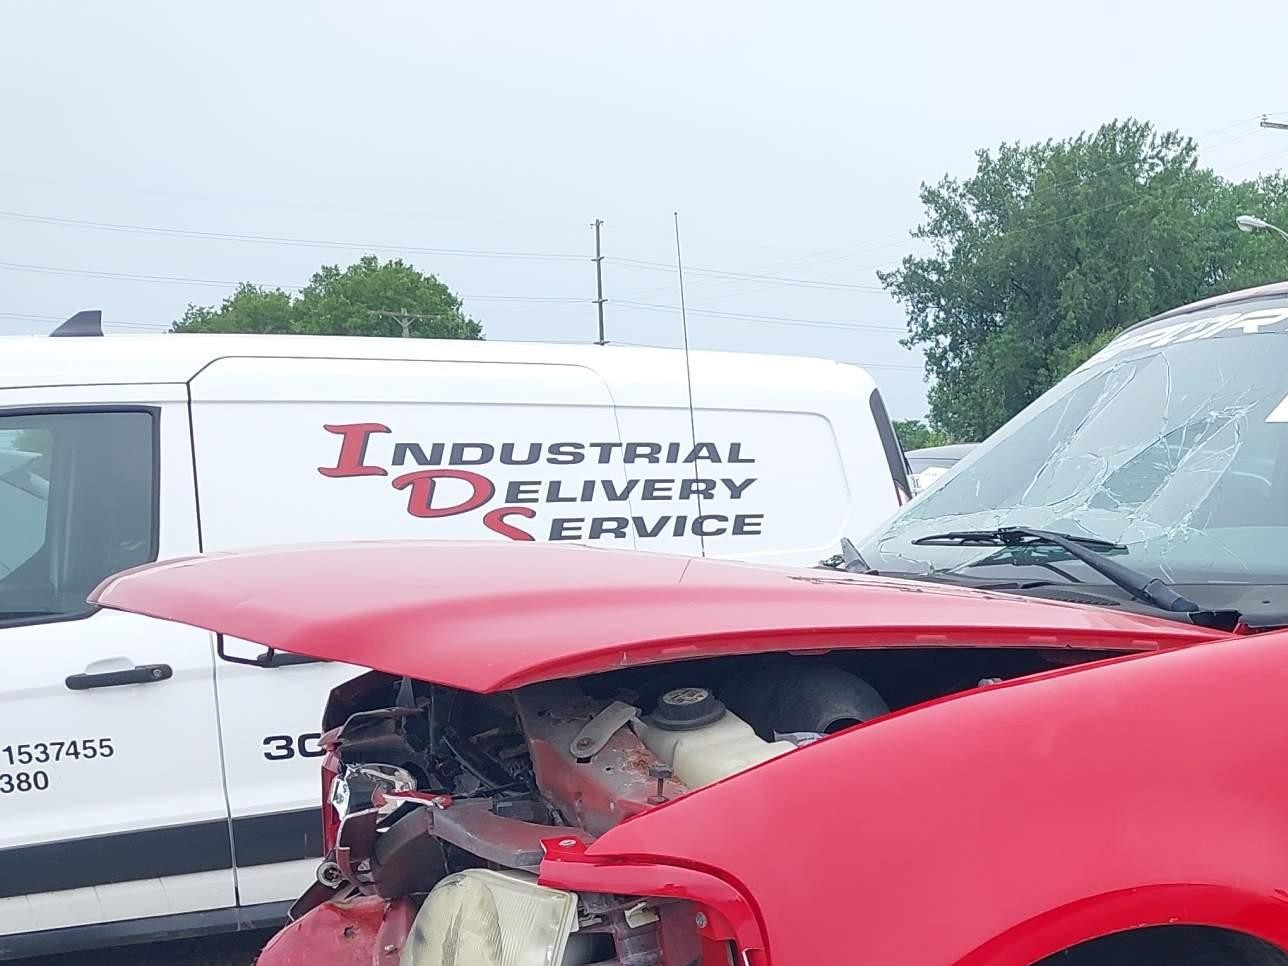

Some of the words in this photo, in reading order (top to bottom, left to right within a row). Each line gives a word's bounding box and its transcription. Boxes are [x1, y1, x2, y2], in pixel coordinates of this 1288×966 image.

[317, 422, 757, 479] INDUSTRIAL
[391, 468, 758, 518] DELIVERY
[482, 506, 765, 542] SERVICE
[2, 738, 114, 765] 1537455
